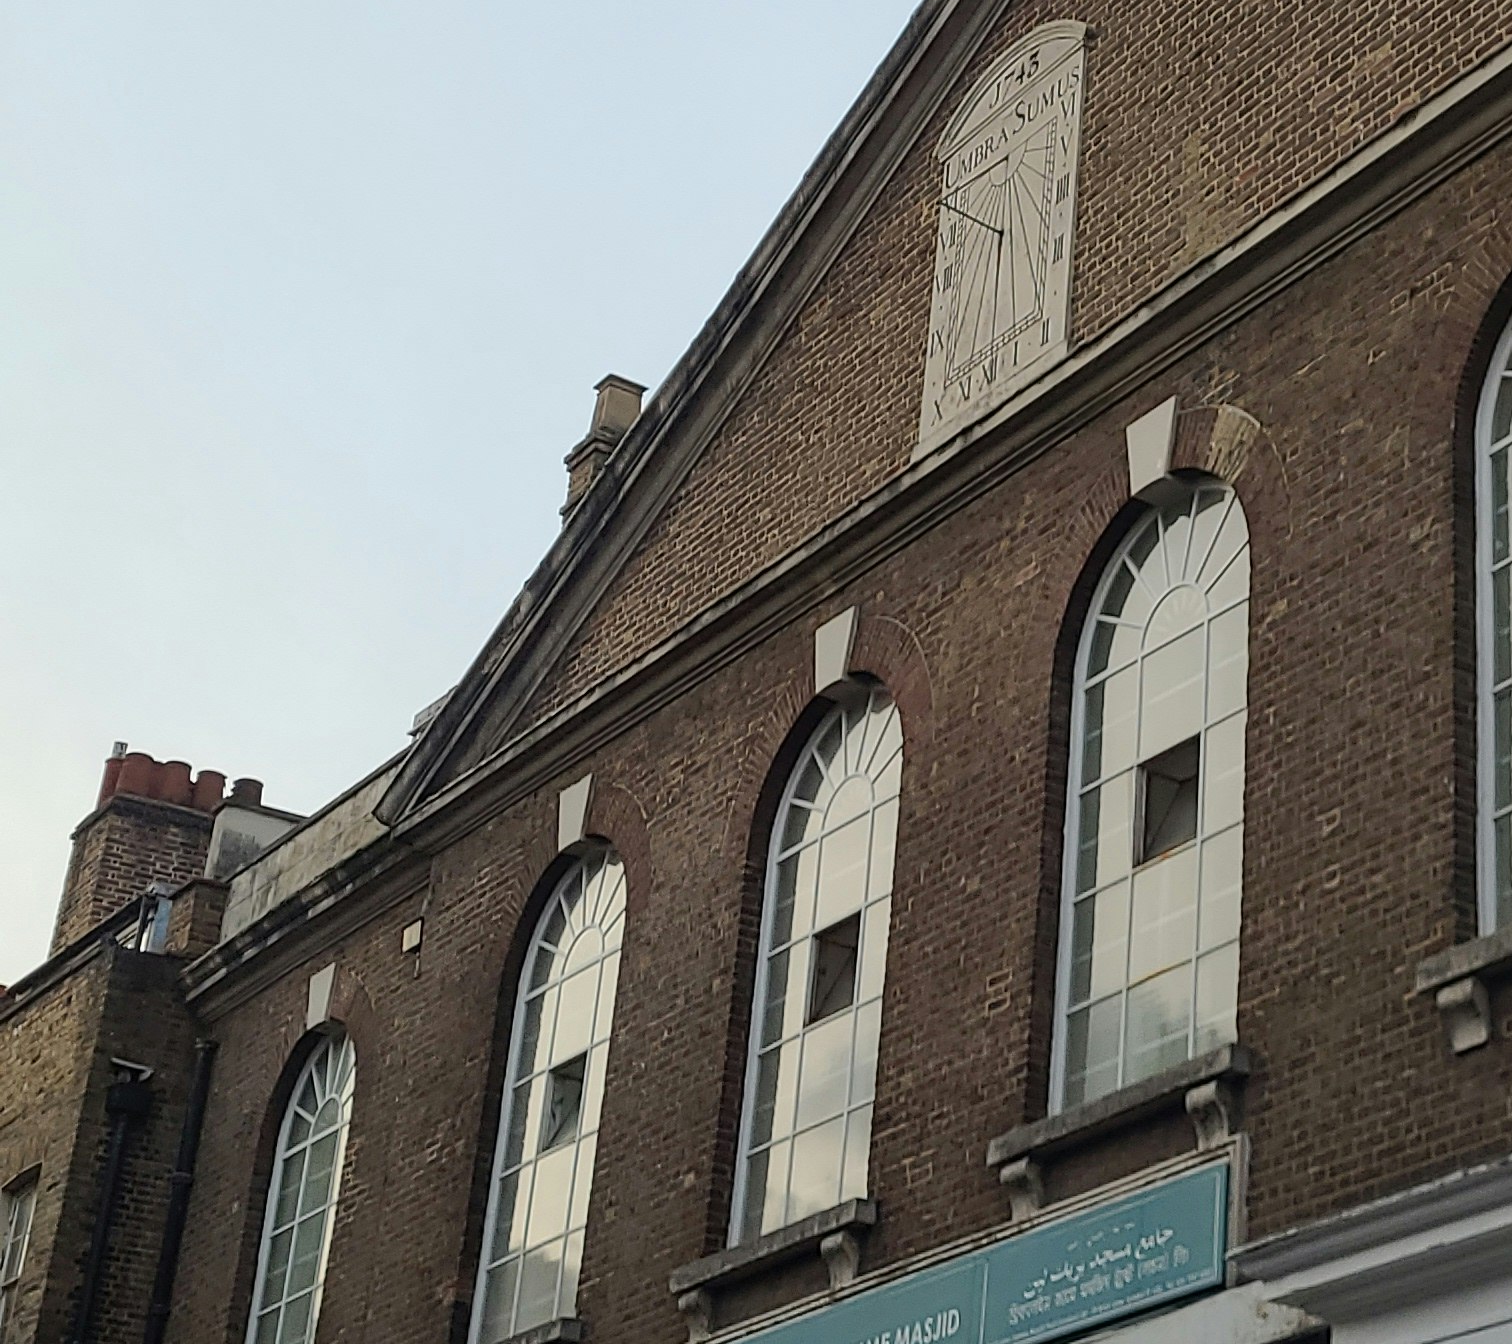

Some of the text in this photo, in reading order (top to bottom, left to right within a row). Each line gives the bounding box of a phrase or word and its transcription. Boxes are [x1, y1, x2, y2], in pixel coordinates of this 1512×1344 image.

[988, 49, 1040, 109] 1743
[944, 65, 1080, 189] UMBRA SUMUS
[1060, 89, 1076, 120] VI
[1060, 127, 1073, 156] V
